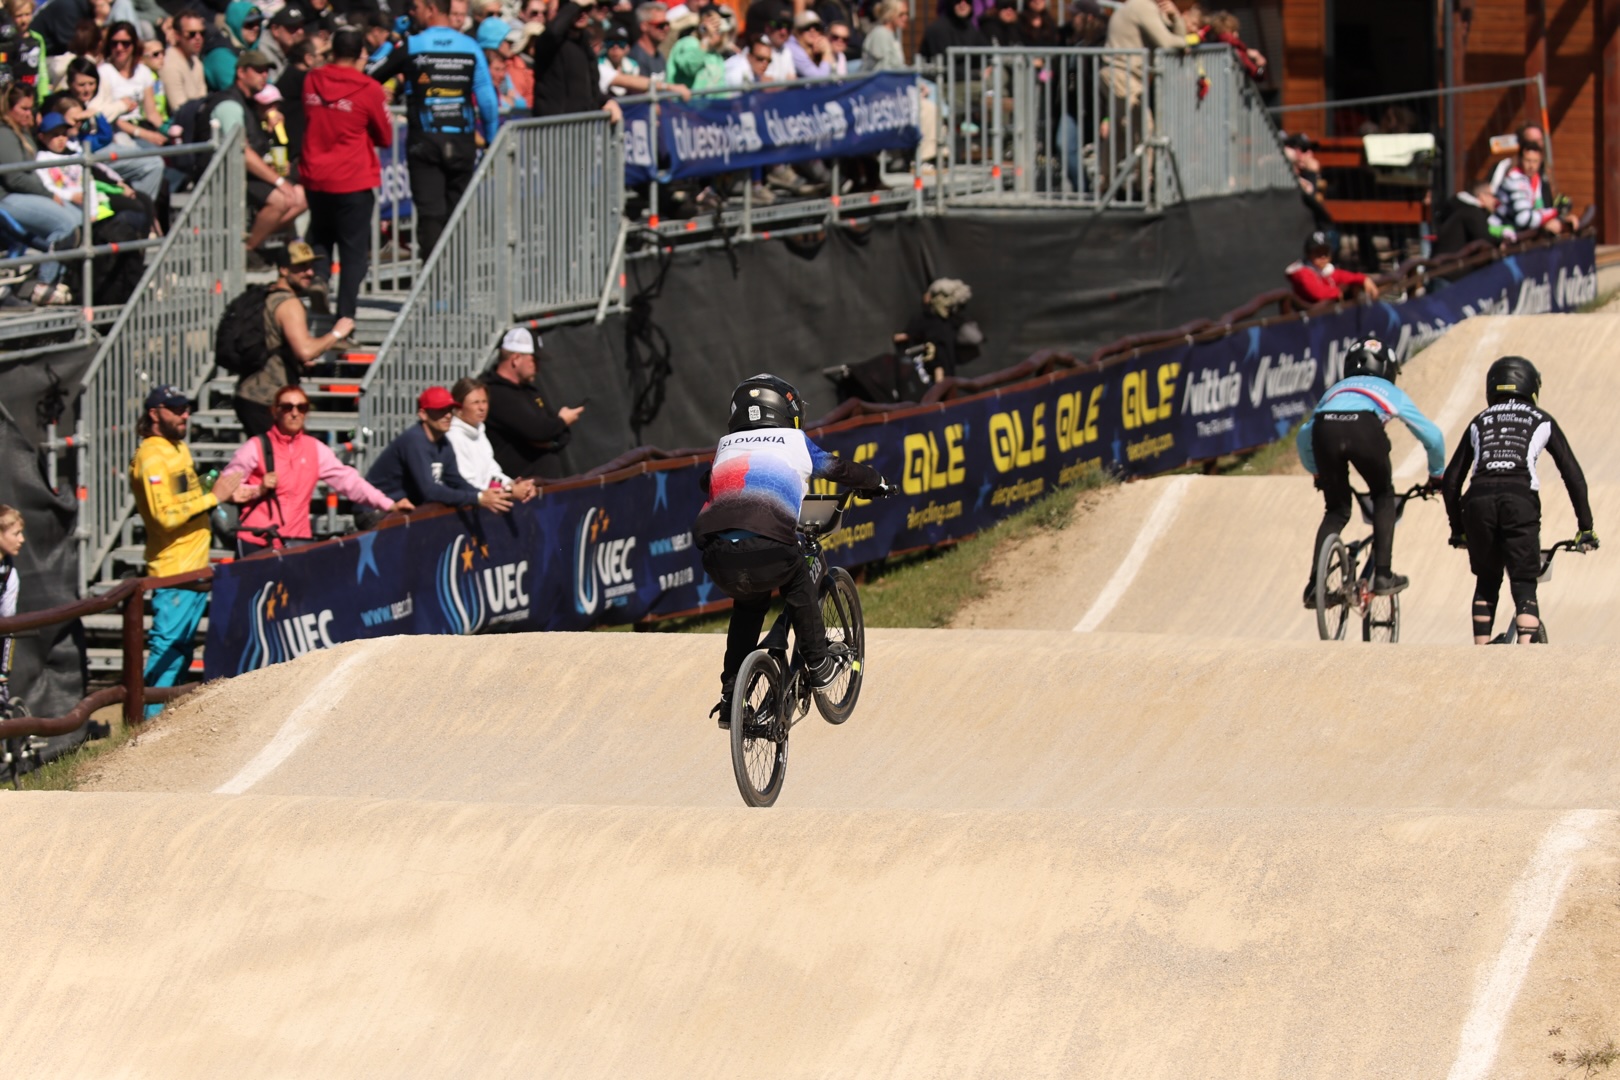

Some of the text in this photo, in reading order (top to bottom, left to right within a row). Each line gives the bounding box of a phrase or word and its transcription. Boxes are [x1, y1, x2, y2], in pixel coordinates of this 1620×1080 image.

[1190, 361, 1242, 416] vittoria
[721, 436, 786, 450] SLOVAKIA
[483, 560, 529, 613] UEC
[597, 536, 636, 586] UEC
